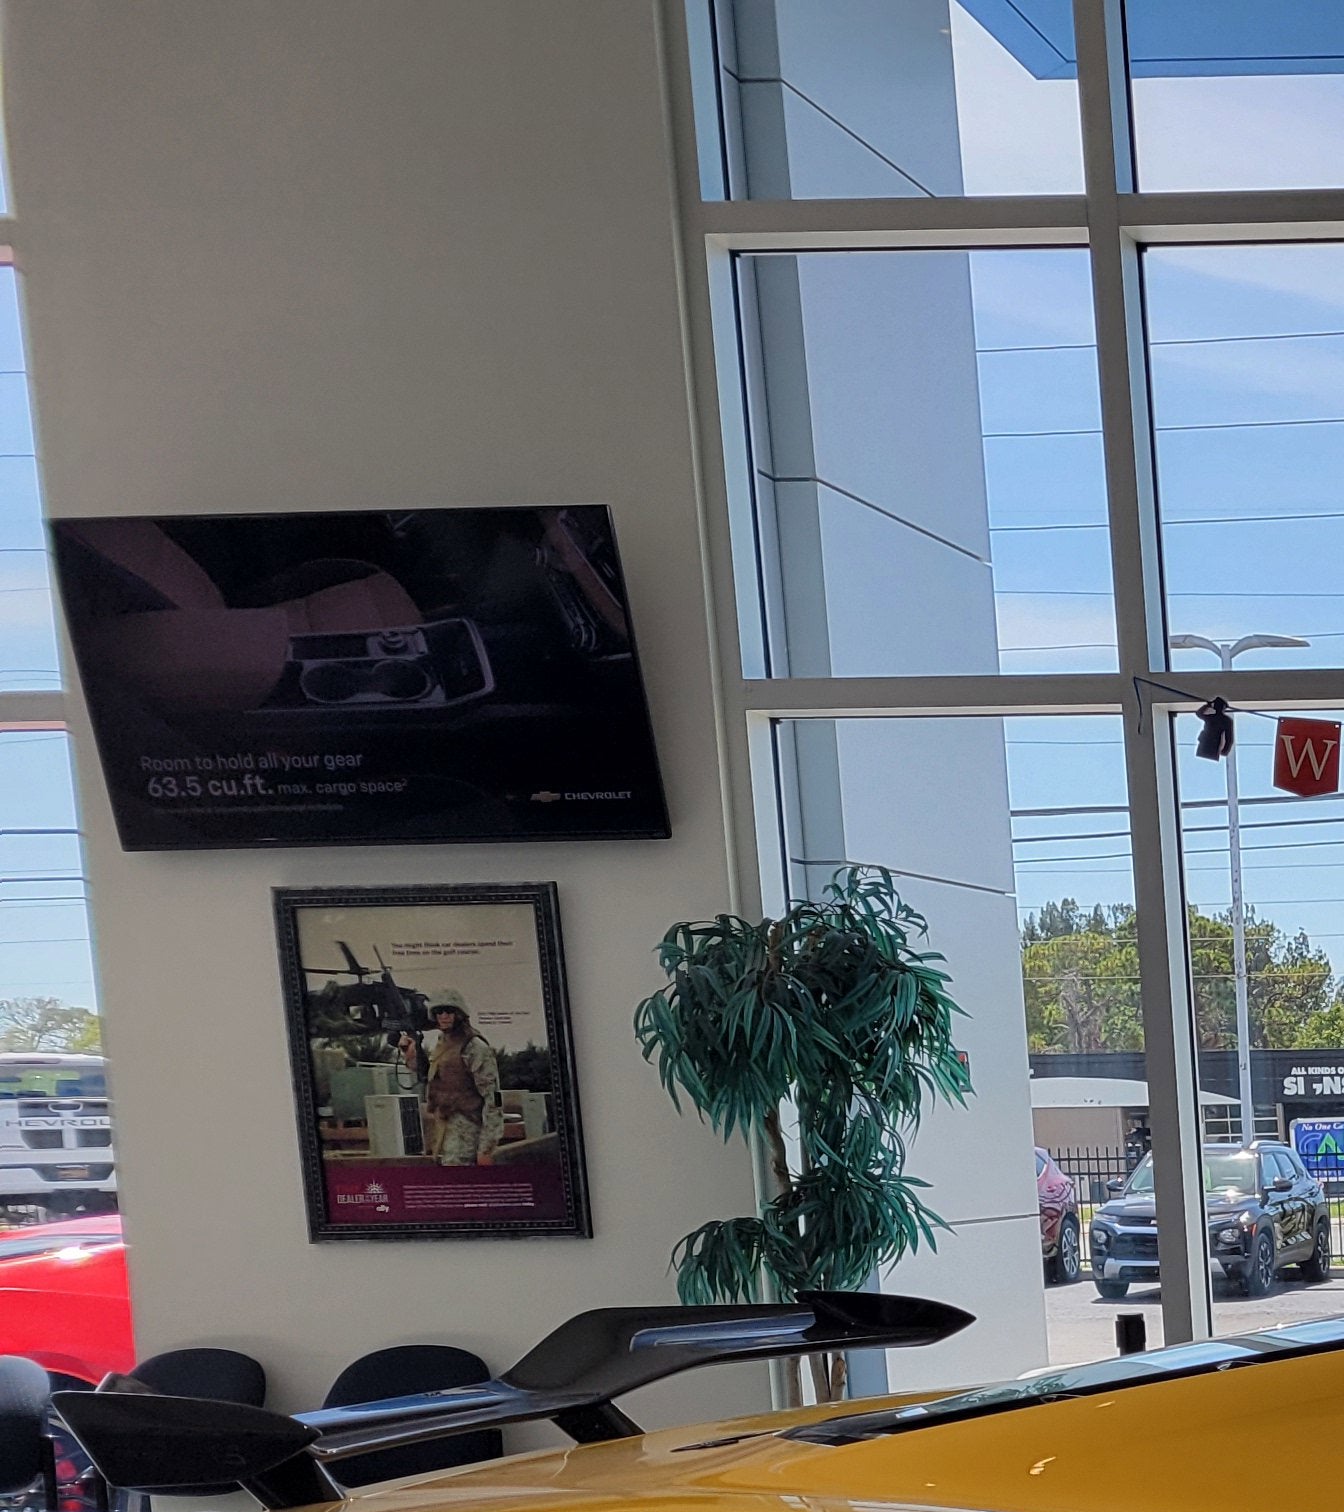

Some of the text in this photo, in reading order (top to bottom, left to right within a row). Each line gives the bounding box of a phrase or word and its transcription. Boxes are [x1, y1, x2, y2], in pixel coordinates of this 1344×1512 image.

[140, 753, 363, 771] Room to hold all your gear
[148, 775, 201, 797] 63.5
[207, 774, 274, 796] cu.ft.
[278, 783, 313, 795] max.
[316, 782, 356, 796] cargo
[565, 791, 632, 800] CHEVROLET
[1291, 1066, 1307, 1075] ALL
[1308, 1066, 1336, 1075] KINDS
